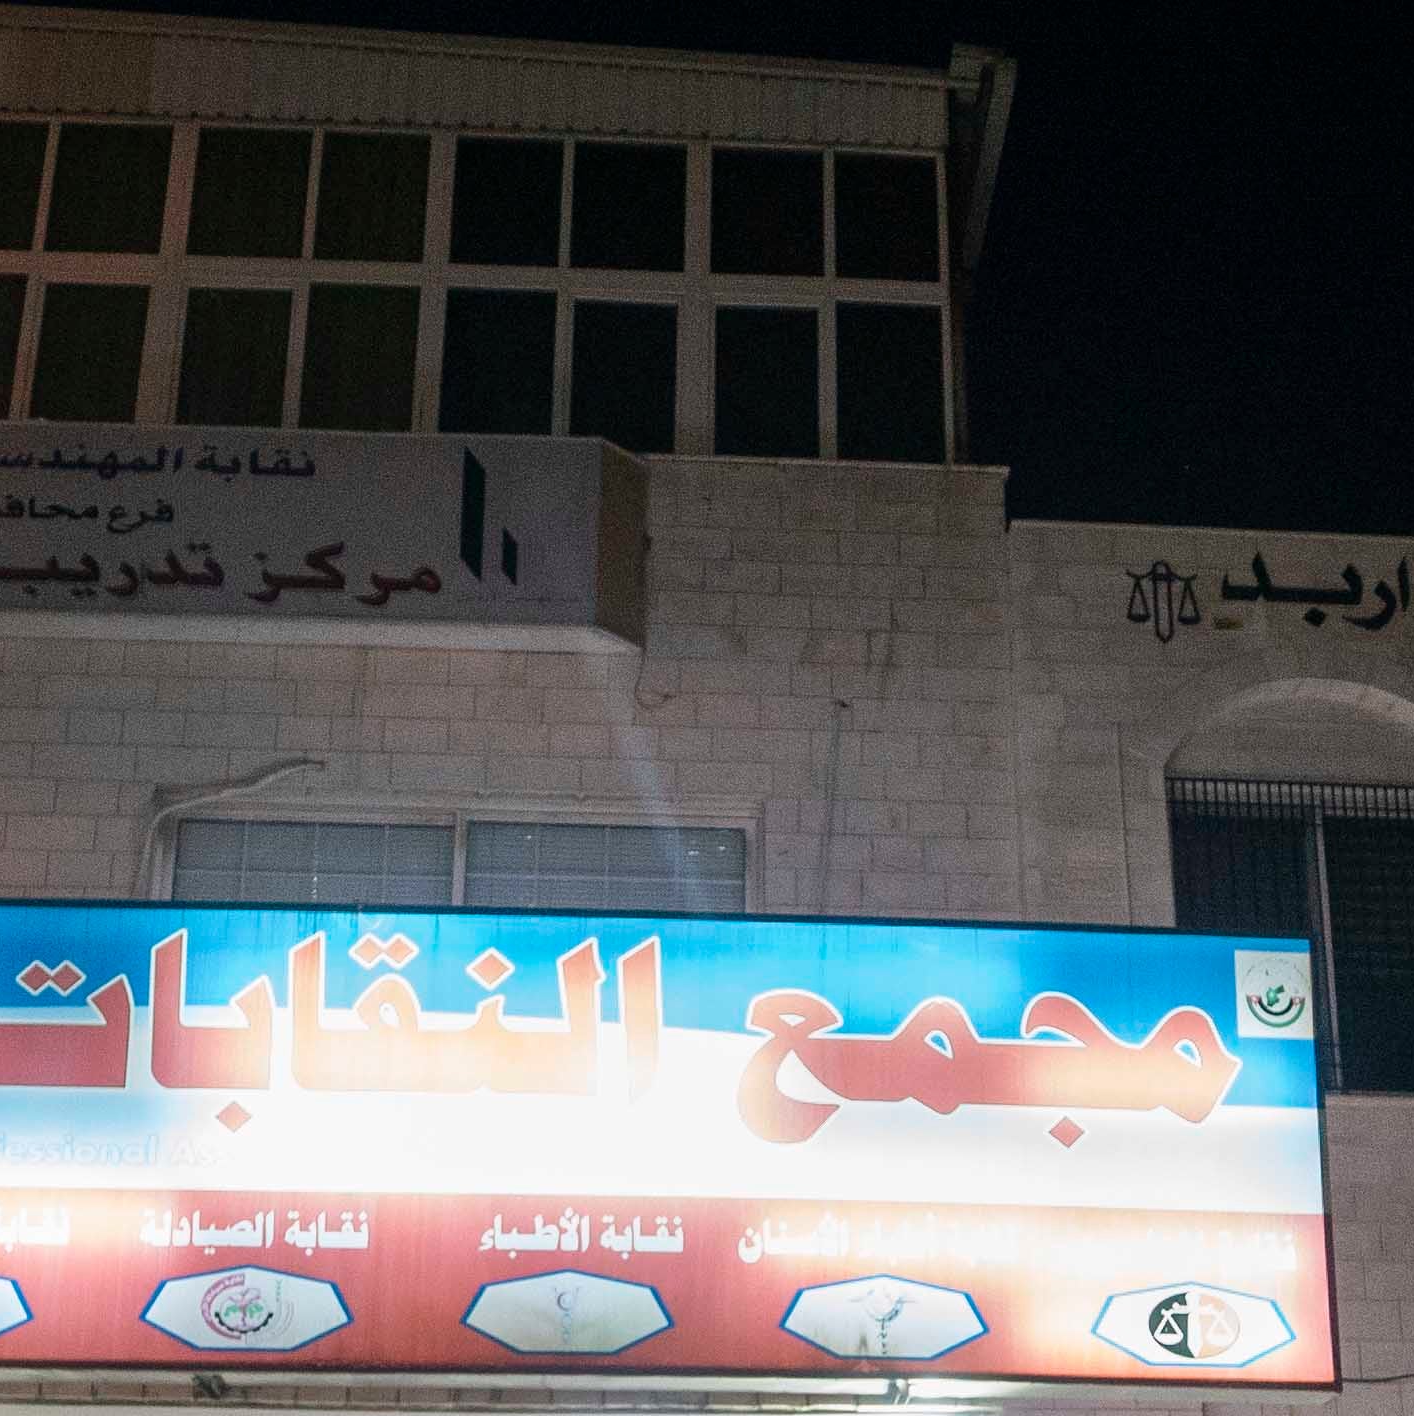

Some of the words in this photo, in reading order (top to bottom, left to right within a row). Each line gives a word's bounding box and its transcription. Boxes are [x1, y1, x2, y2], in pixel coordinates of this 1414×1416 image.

[191, 447, 316, 478] نقابة
[105, 497, 175, 533] فرع
[245, 538, 444, 606] مركز
[1221, 550, 1410, 632] اربد
[735, 983, 1243, 1150] مجمع
[139, 1208, 275, 1255] الصيادلة
[284, 1209, 370, 1257] نقابة
[478, 1206, 590, 1260] الأطباء
[597, 1212, 684, 1261] نقابة
